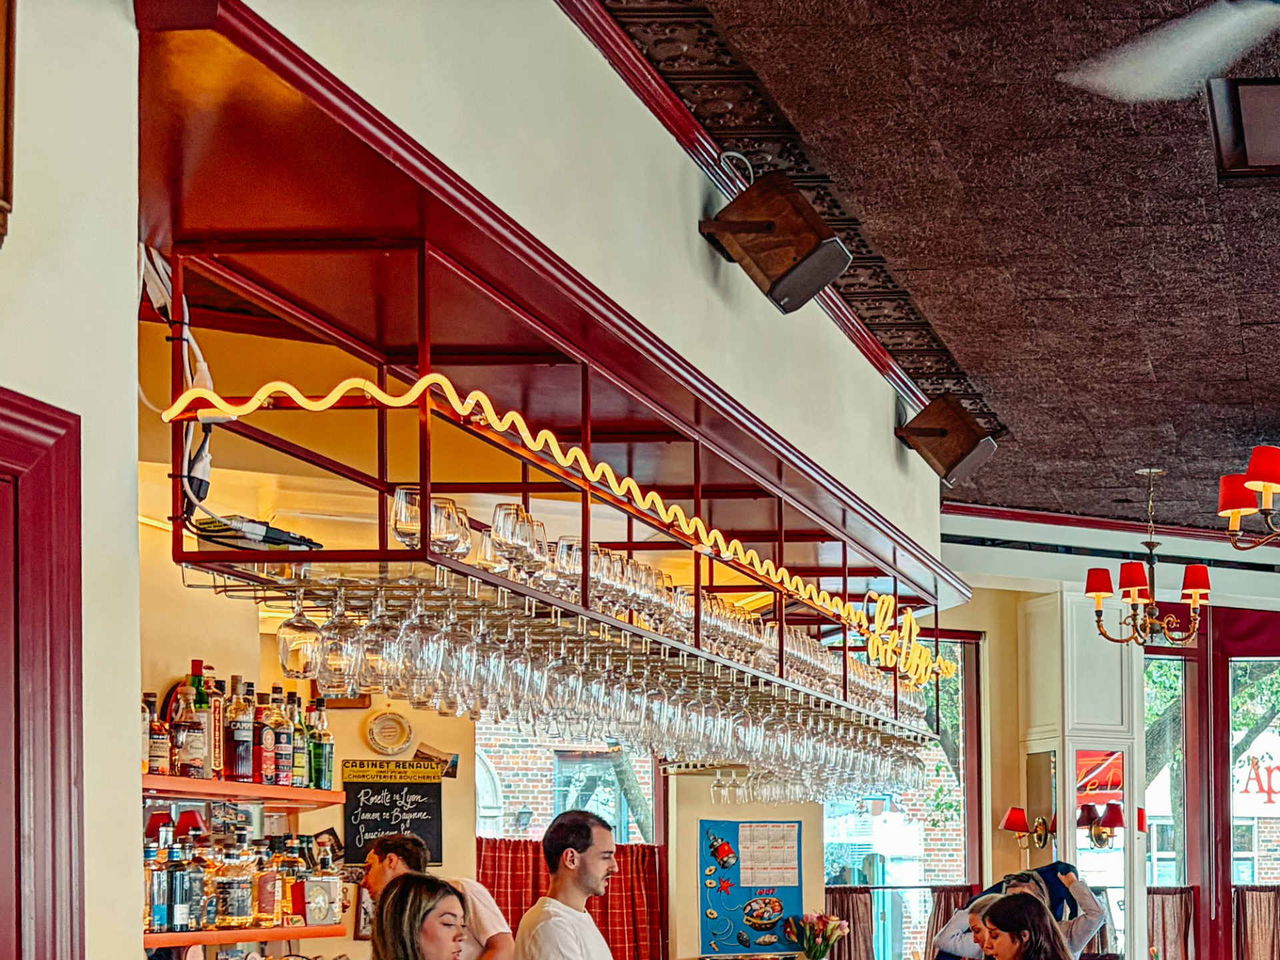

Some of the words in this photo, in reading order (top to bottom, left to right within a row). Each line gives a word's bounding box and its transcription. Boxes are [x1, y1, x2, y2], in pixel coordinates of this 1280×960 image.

[343, 760, 391, 769] CABINET
[394, 761, 440, 770] RENAULT
[357, 788, 390, 807] Rosette
